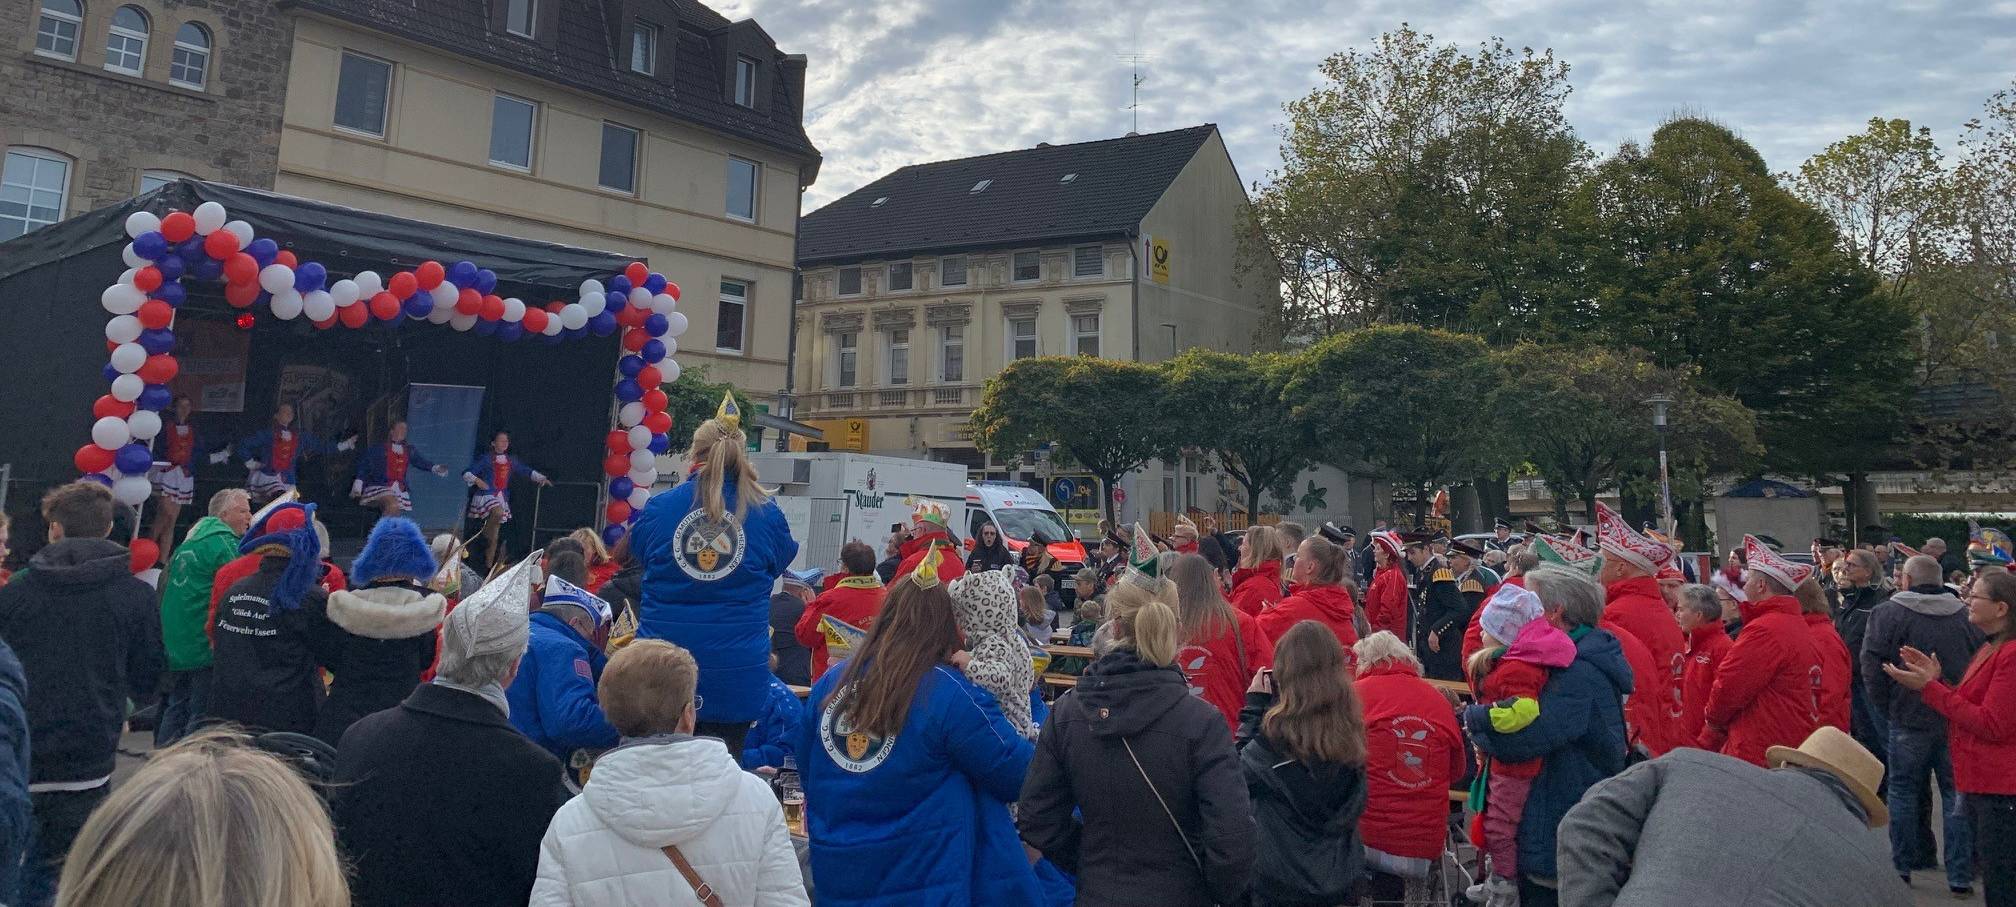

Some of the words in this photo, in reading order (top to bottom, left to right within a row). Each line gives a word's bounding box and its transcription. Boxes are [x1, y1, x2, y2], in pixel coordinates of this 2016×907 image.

[855, 490, 884, 510] Stauder
[228, 593, 270, 606] Spielmanns
[218, 619, 254, 635] Feuerwehr
[254, 628, 277, 637] Essen
[845, 762, 863, 770] 1882
